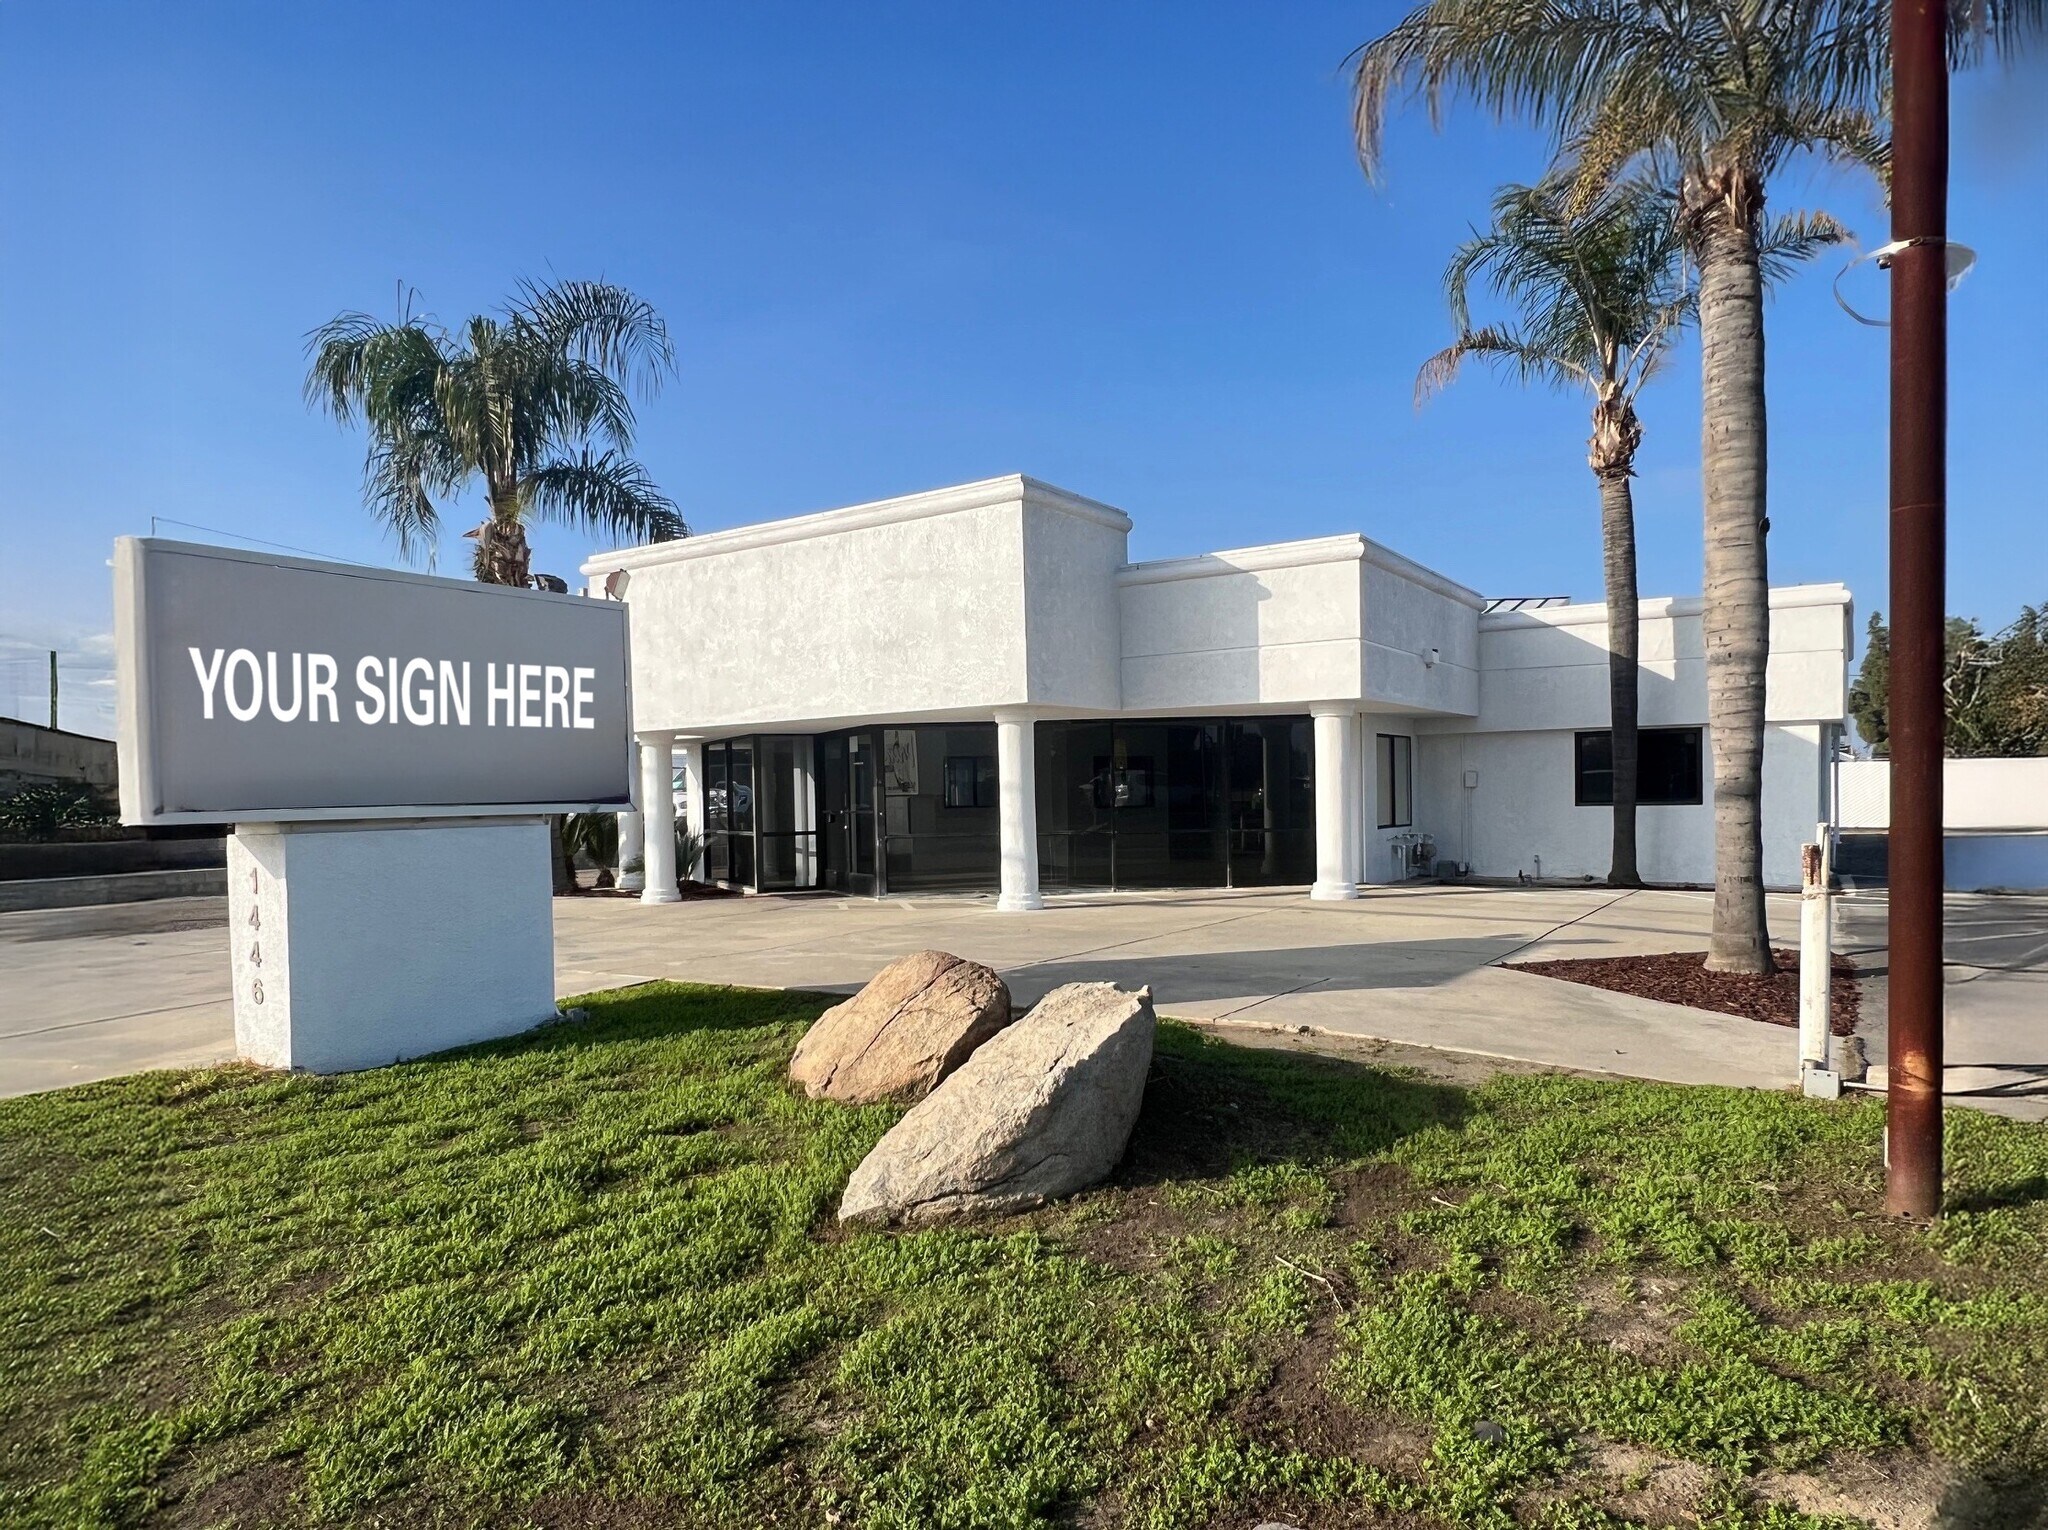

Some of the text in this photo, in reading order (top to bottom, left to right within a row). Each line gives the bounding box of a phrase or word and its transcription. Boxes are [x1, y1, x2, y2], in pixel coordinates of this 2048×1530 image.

[188, 647, 595, 729] YOUR SIGN HERE
[248, 867, 265, 1005] 1446
